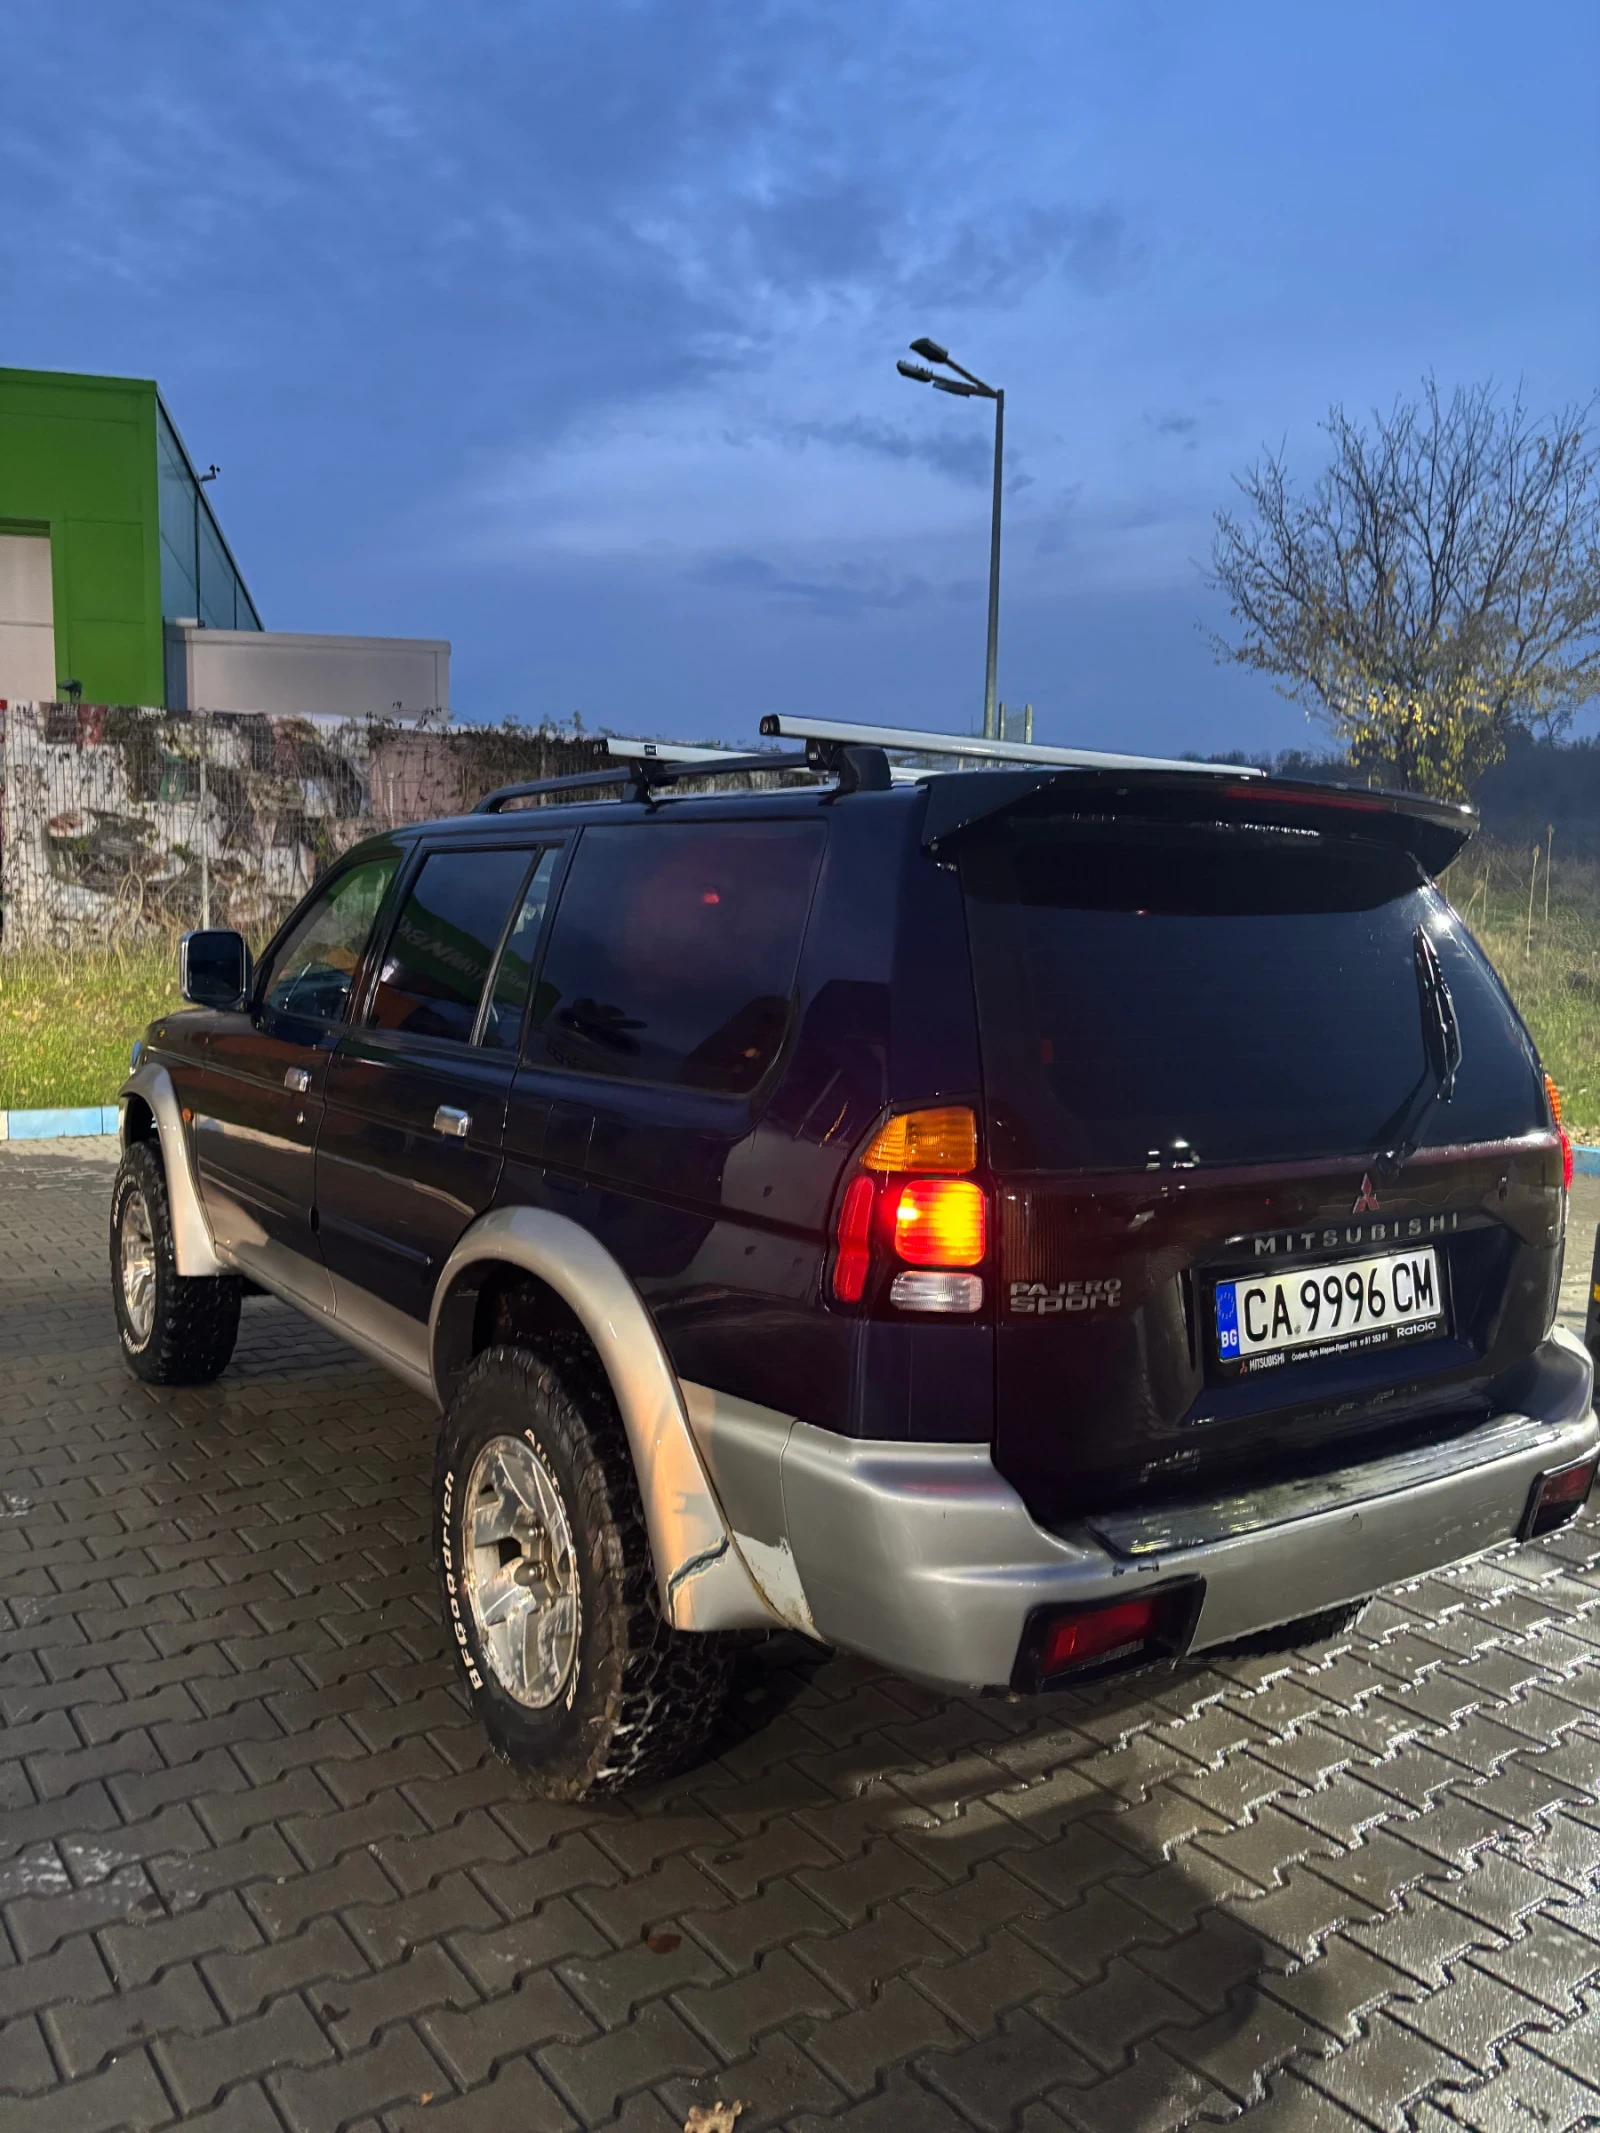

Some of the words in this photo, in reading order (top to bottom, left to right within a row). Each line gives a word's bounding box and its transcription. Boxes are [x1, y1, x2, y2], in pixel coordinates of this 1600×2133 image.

[1255, 1212, 1458, 1255] MITSUBISHI
[1010, 1278, 1122, 1296] PAJERO
[1221, 1330, 1238, 1348] BG
[1396, 1321, 1436, 1338] Ratola
[1249, 1352, 1285, 1372] MITSUBISHI
[442, 1471, 484, 1690] BFGoodrich
